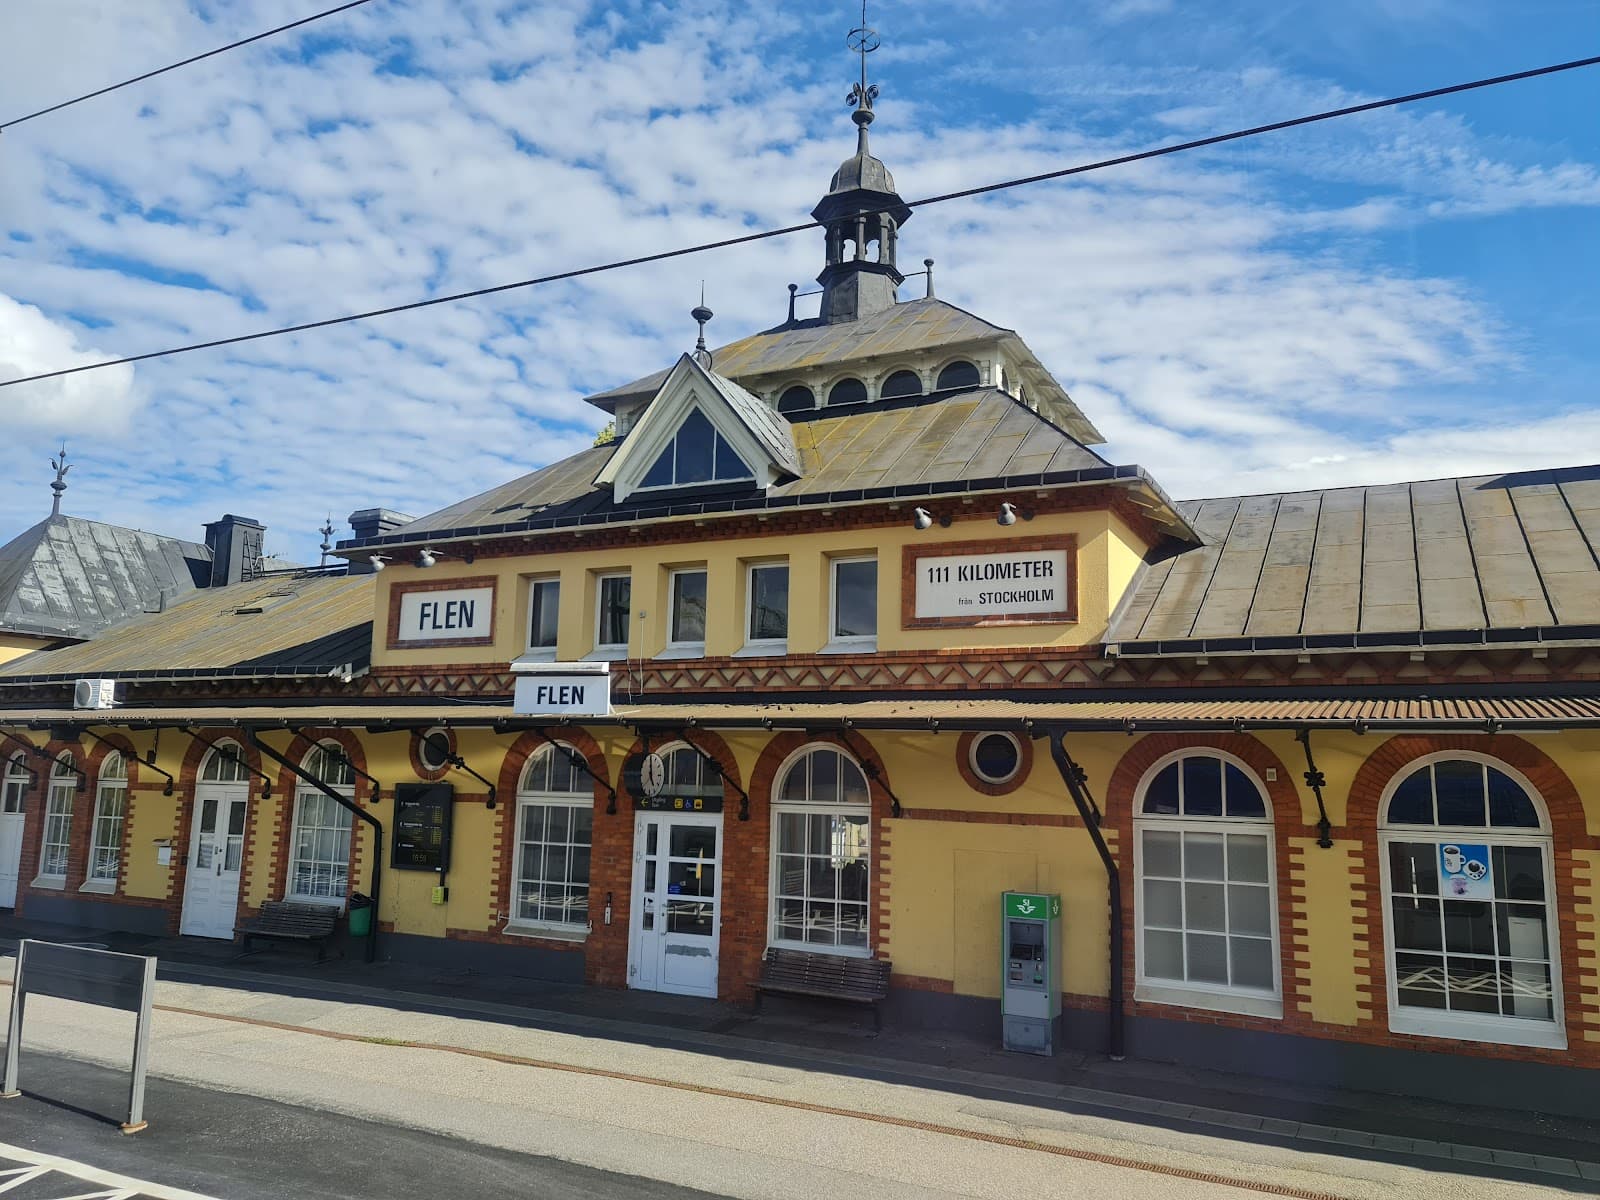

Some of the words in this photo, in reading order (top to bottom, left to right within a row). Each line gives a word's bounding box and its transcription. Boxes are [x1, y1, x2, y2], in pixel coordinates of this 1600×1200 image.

[927, 566, 949, 584] 111
[958, 560, 1053, 582] KILOMETER
[979, 588, 1054, 605] STOCKHOLM
[419, 600, 475, 631] FLEN
[536, 685, 585, 705] FLEN
